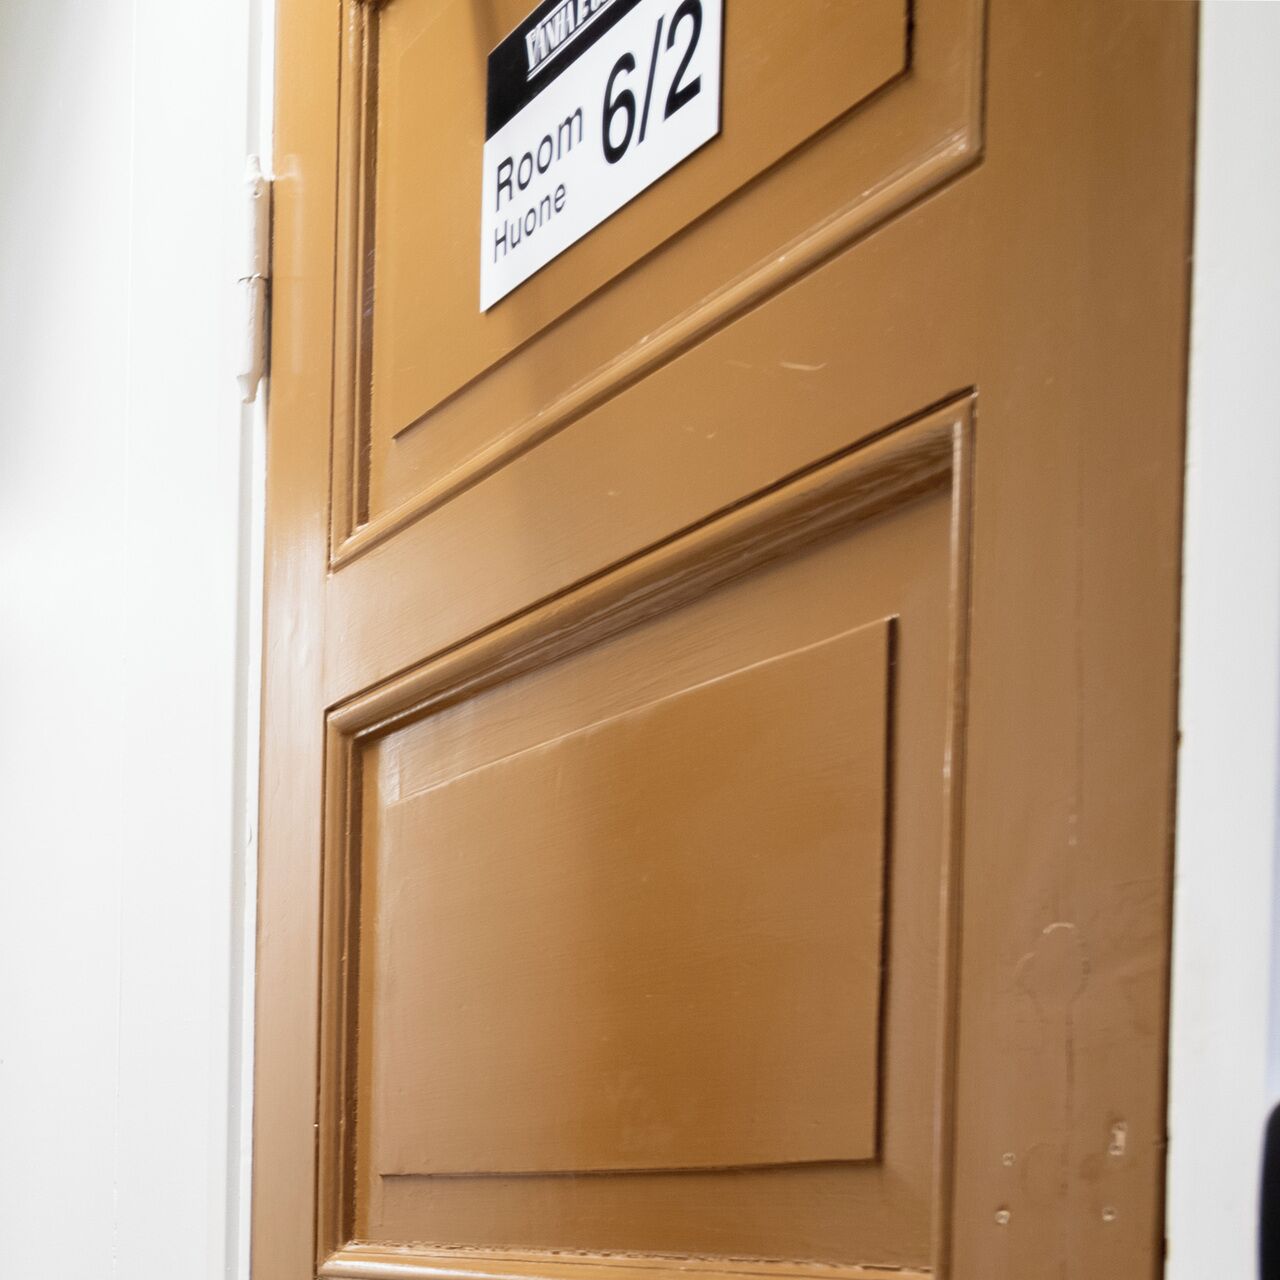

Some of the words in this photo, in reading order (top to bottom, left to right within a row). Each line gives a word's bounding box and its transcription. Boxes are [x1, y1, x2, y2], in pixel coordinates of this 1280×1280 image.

[495, 105, 583, 213] Room
[602, 0, 703, 164] 6/2
[493, 182, 567, 265] Huone
